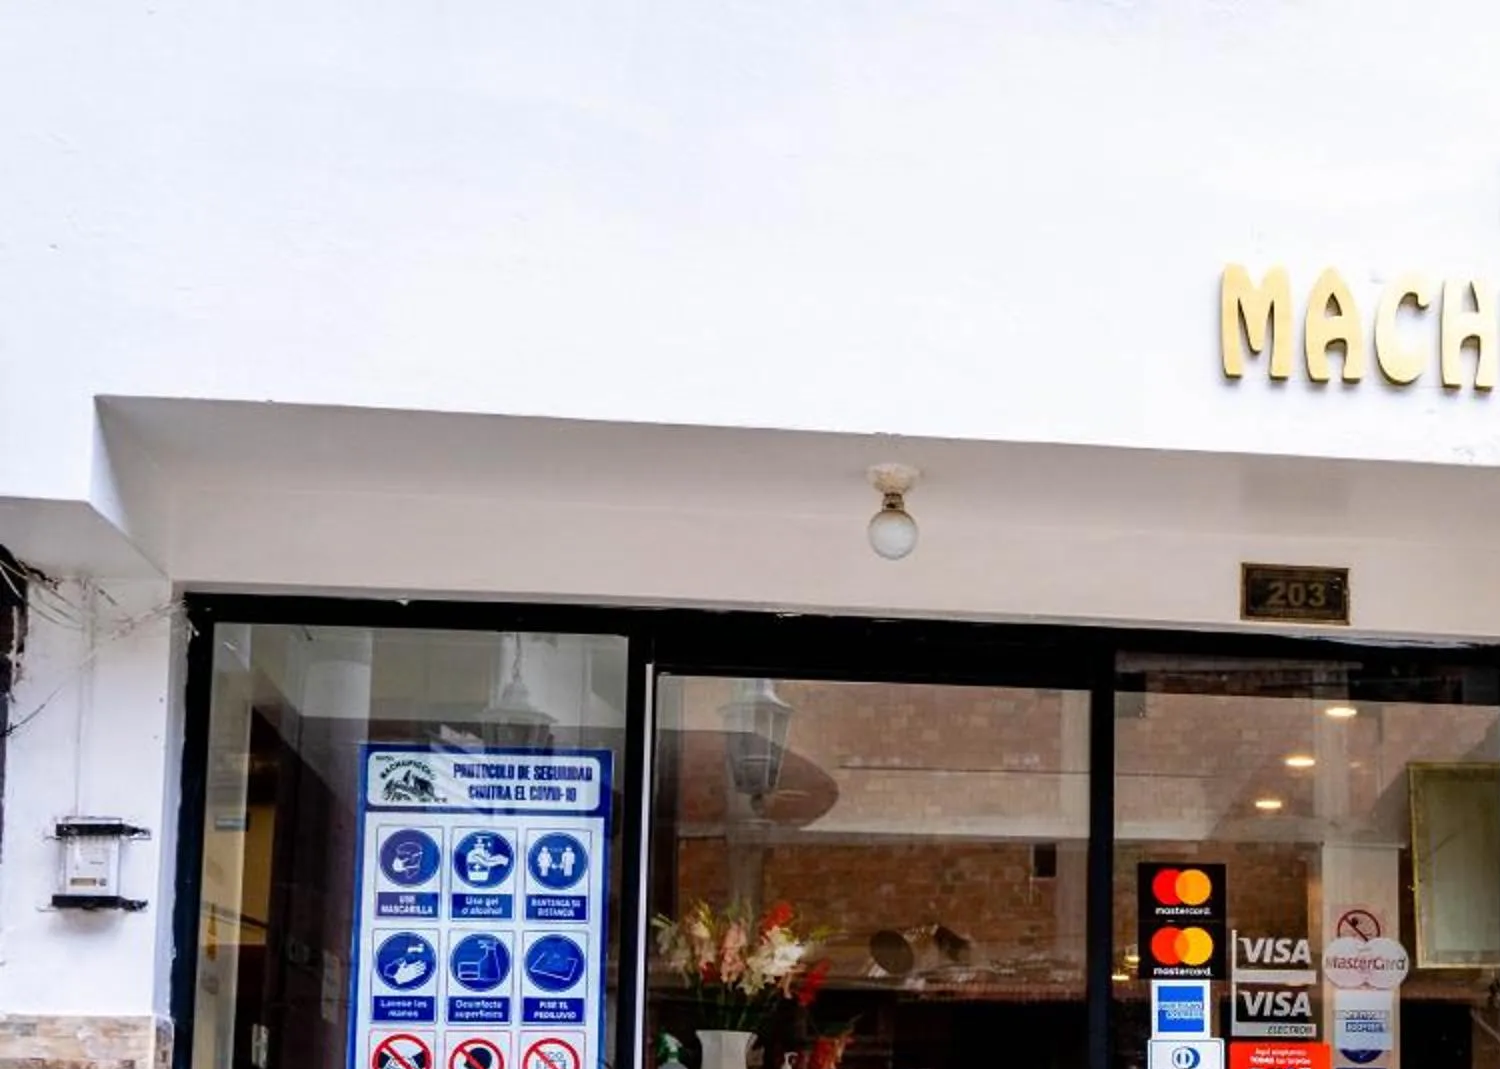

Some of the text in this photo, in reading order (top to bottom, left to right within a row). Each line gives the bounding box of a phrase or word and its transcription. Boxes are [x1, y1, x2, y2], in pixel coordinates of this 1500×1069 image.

[1266, 582, 1326, 607] 203
[517, 765, 531, 781] DE
[514, 786, 526, 801] EL
[1237, 937, 1313, 964] VISA
[1237, 990, 1313, 1017] VISA
[1266, 1025, 1313, 1034] ELECTRON
